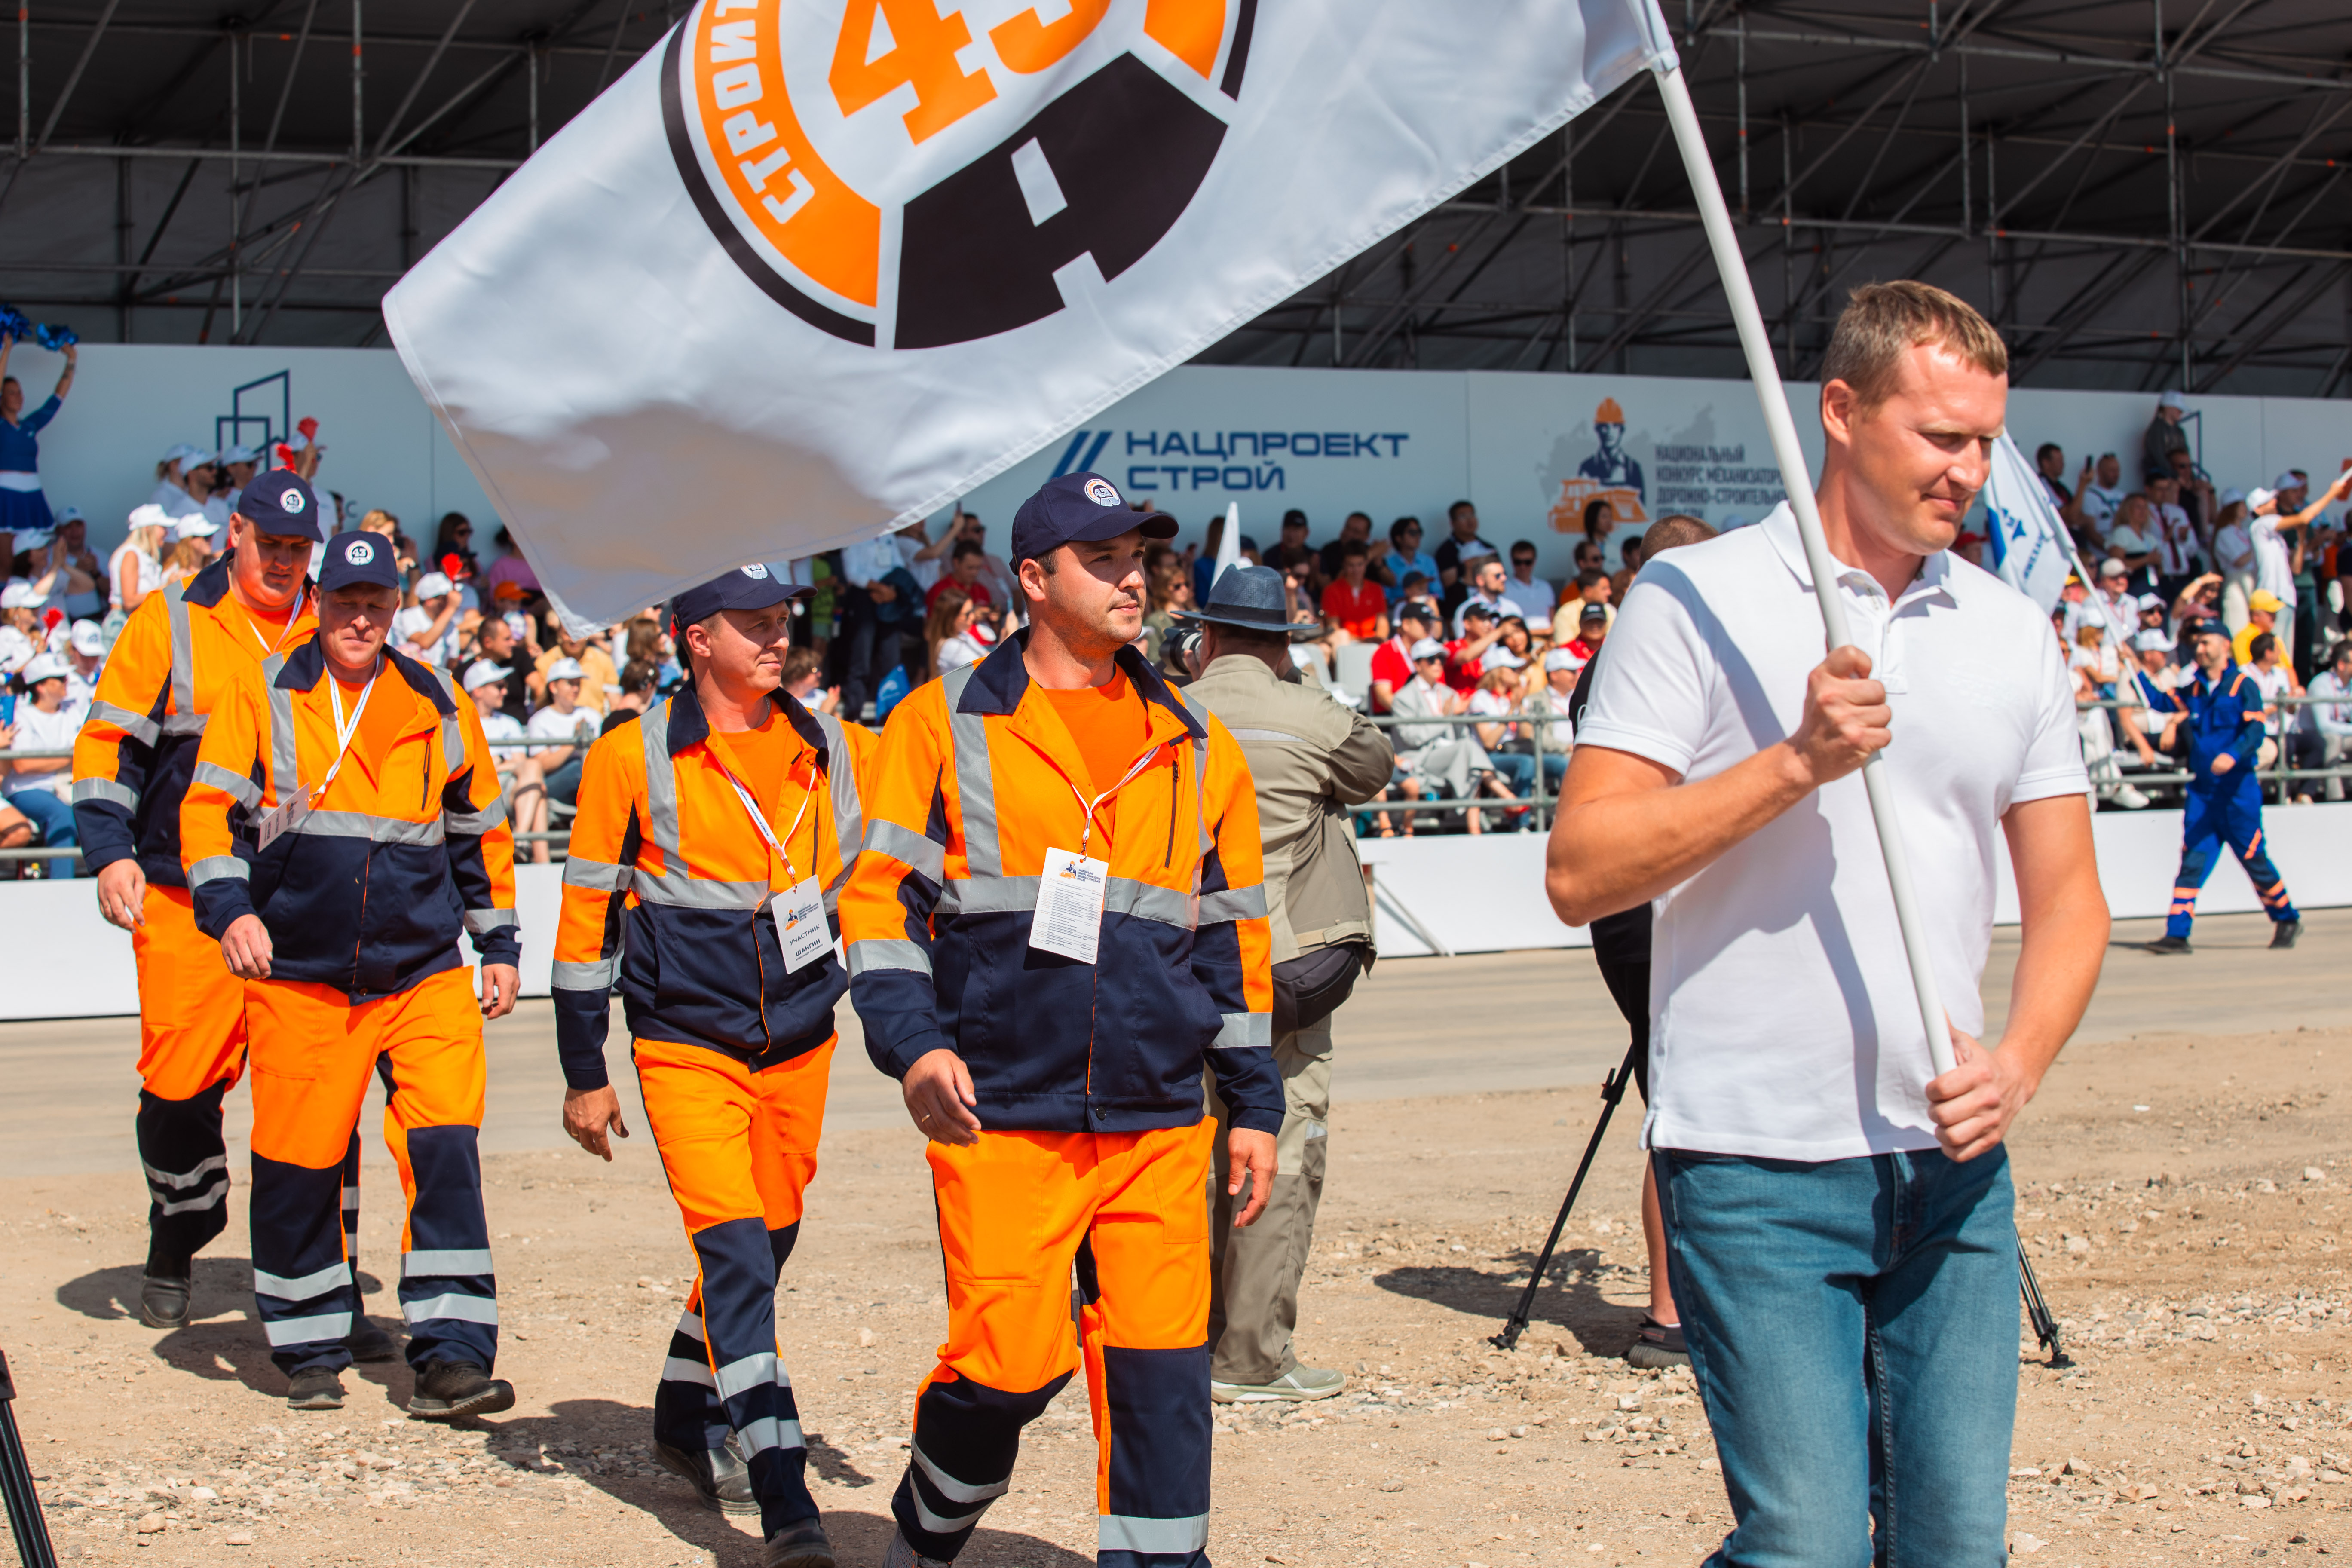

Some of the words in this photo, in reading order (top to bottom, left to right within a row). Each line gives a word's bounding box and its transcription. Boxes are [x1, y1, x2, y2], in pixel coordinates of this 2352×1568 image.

[1126, 431, 1409, 462] НАЦПРОЕКТ
[1656, 444, 1745, 462] НАЦИОНАЛЬНЫЙ
[1127, 460, 1285, 491] СТРОЙ
[1656, 466, 1704, 484] КОНКУРС
[1706, 466, 1785, 486] МЕХАНИЗАТОР
[1094, 487, 1112, 498] 43
[1657, 487, 1788, 506] ДОРОЖНО-СТРОИТЕЛЬНО
[352, 548, 367, 557] 43
[790, 924, 820, 946] УЧАСТНИК
[796, 939, 820, 956] ШАНГИН
